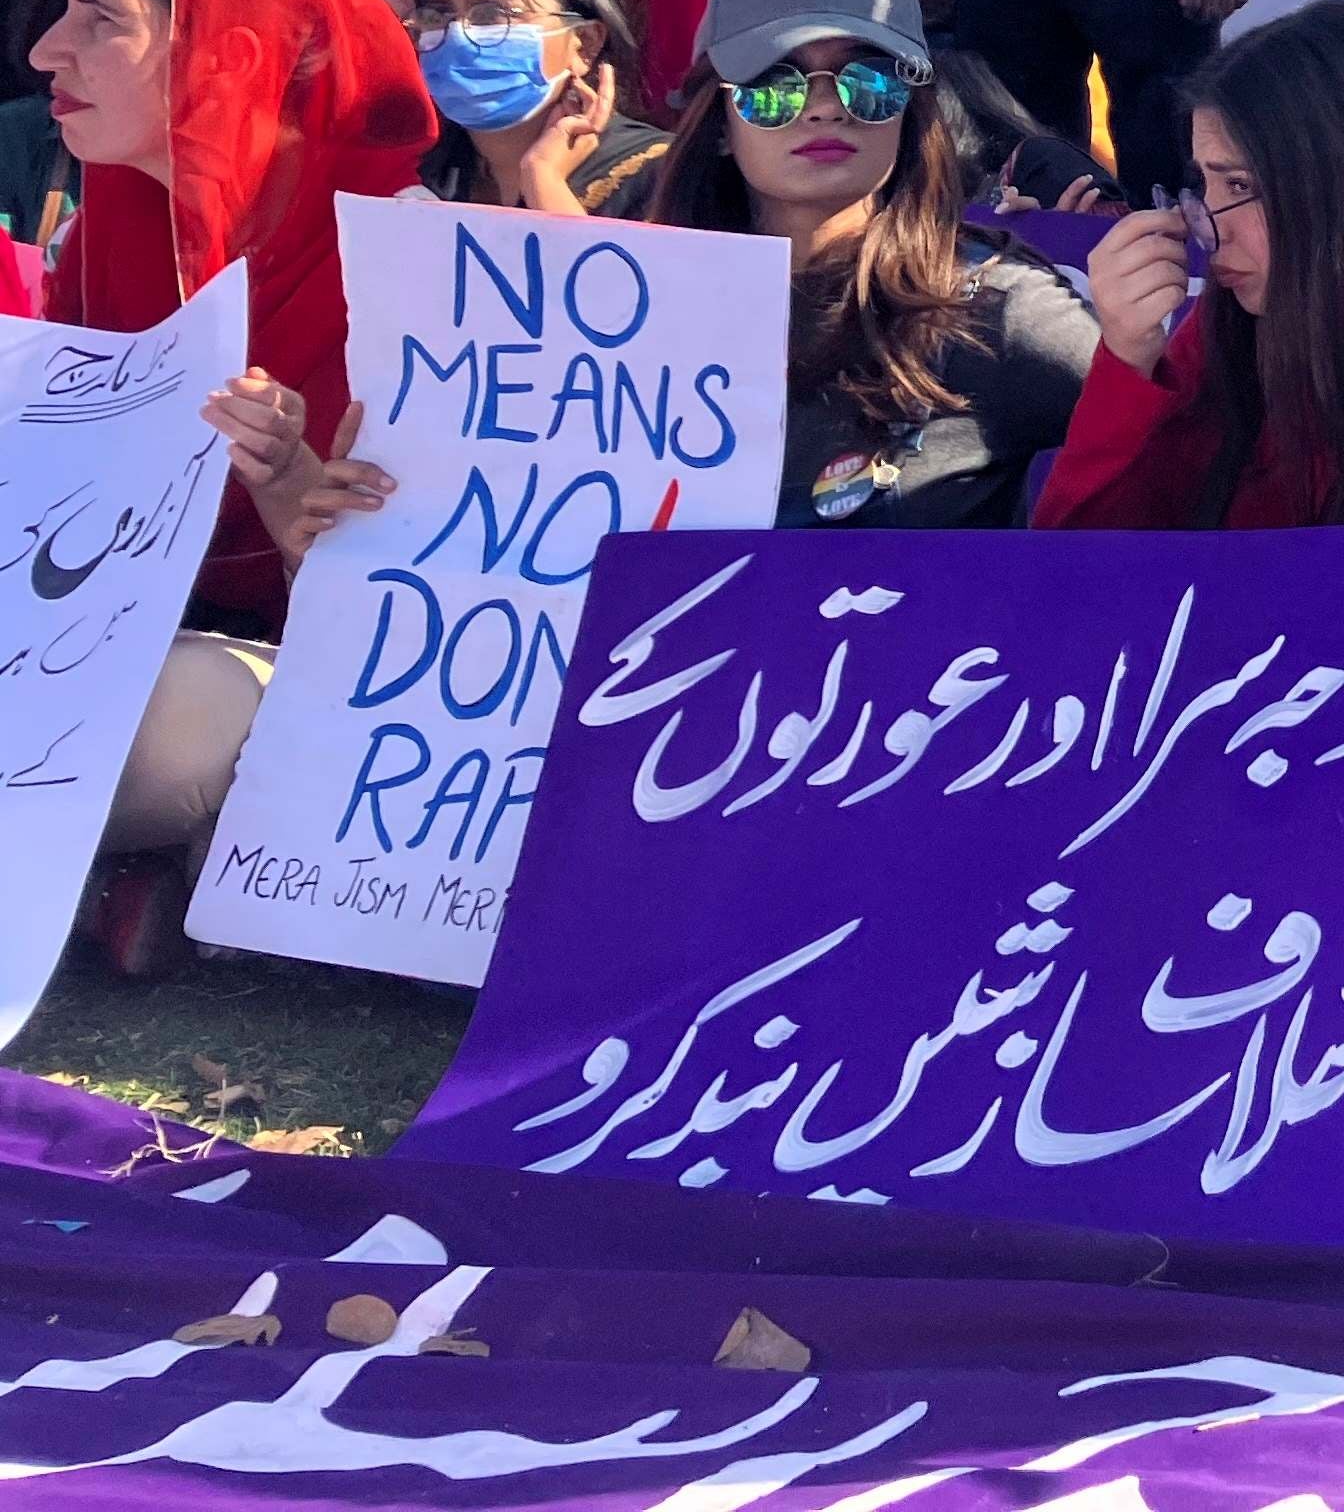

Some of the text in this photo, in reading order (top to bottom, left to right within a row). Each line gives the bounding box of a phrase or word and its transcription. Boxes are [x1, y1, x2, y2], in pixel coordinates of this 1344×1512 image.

[453, 221, 650, 349] NO
[388, 334, 738, 469] MEANS
[578, 552, 754, 728] کے
[632, 585, 1010, 824] عورتوں
[944, 644, 1130, 797] اور
[1058, 583, 1285, 859] سرا
[215, 844, 321, 905] MERA
[334, 857, 407, 920] JISM
[513, 917, 864, 1175] کرو
[625, 1012, 803, 1189] بند
[773, 880, 1232, 1206] سازشیں
